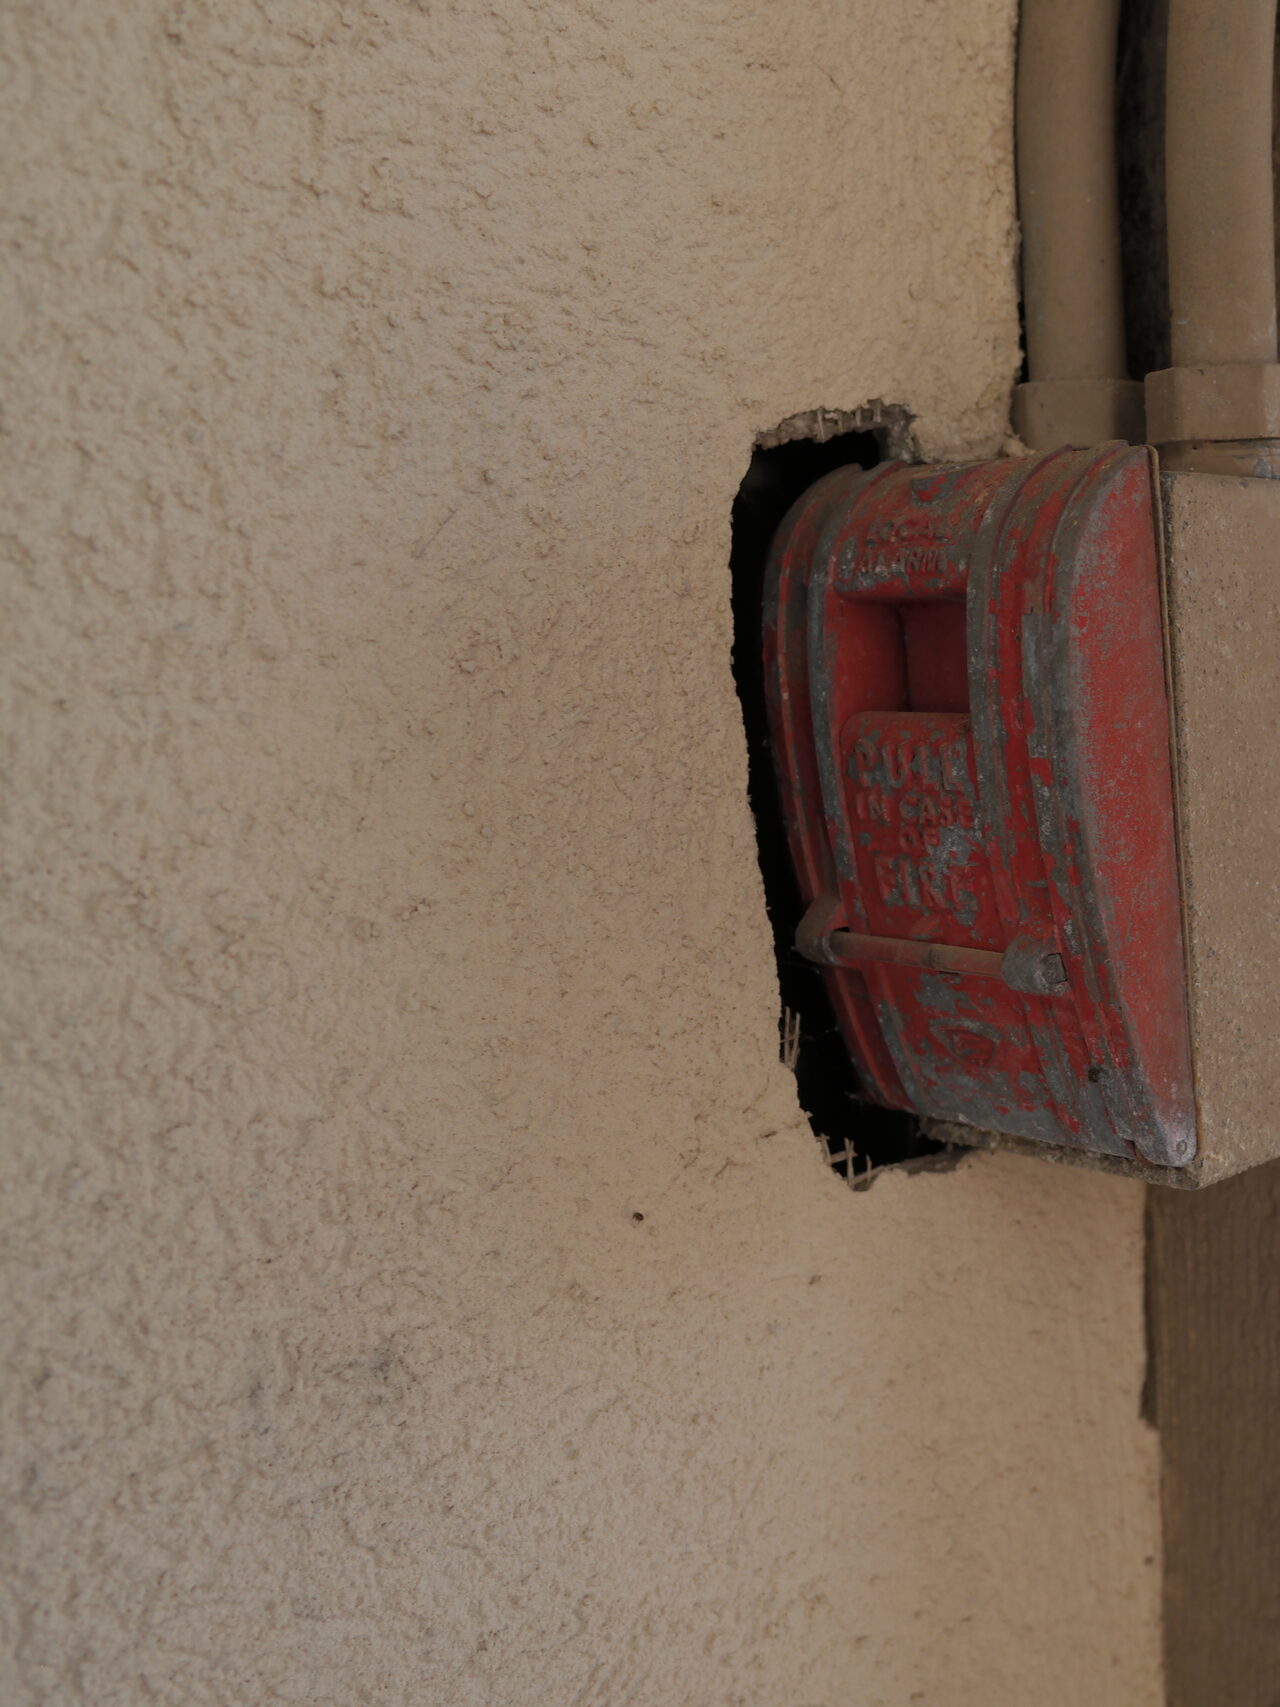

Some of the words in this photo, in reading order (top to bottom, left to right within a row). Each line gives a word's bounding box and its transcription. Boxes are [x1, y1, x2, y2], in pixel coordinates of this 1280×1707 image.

[855, 740, 967, 791] PULL
[855, 792, 891, 826] IN
[900, 794, 974, 829] CASE
[900, 826, 941, 853] OF
[874, 854, 978, 913] FIRE
